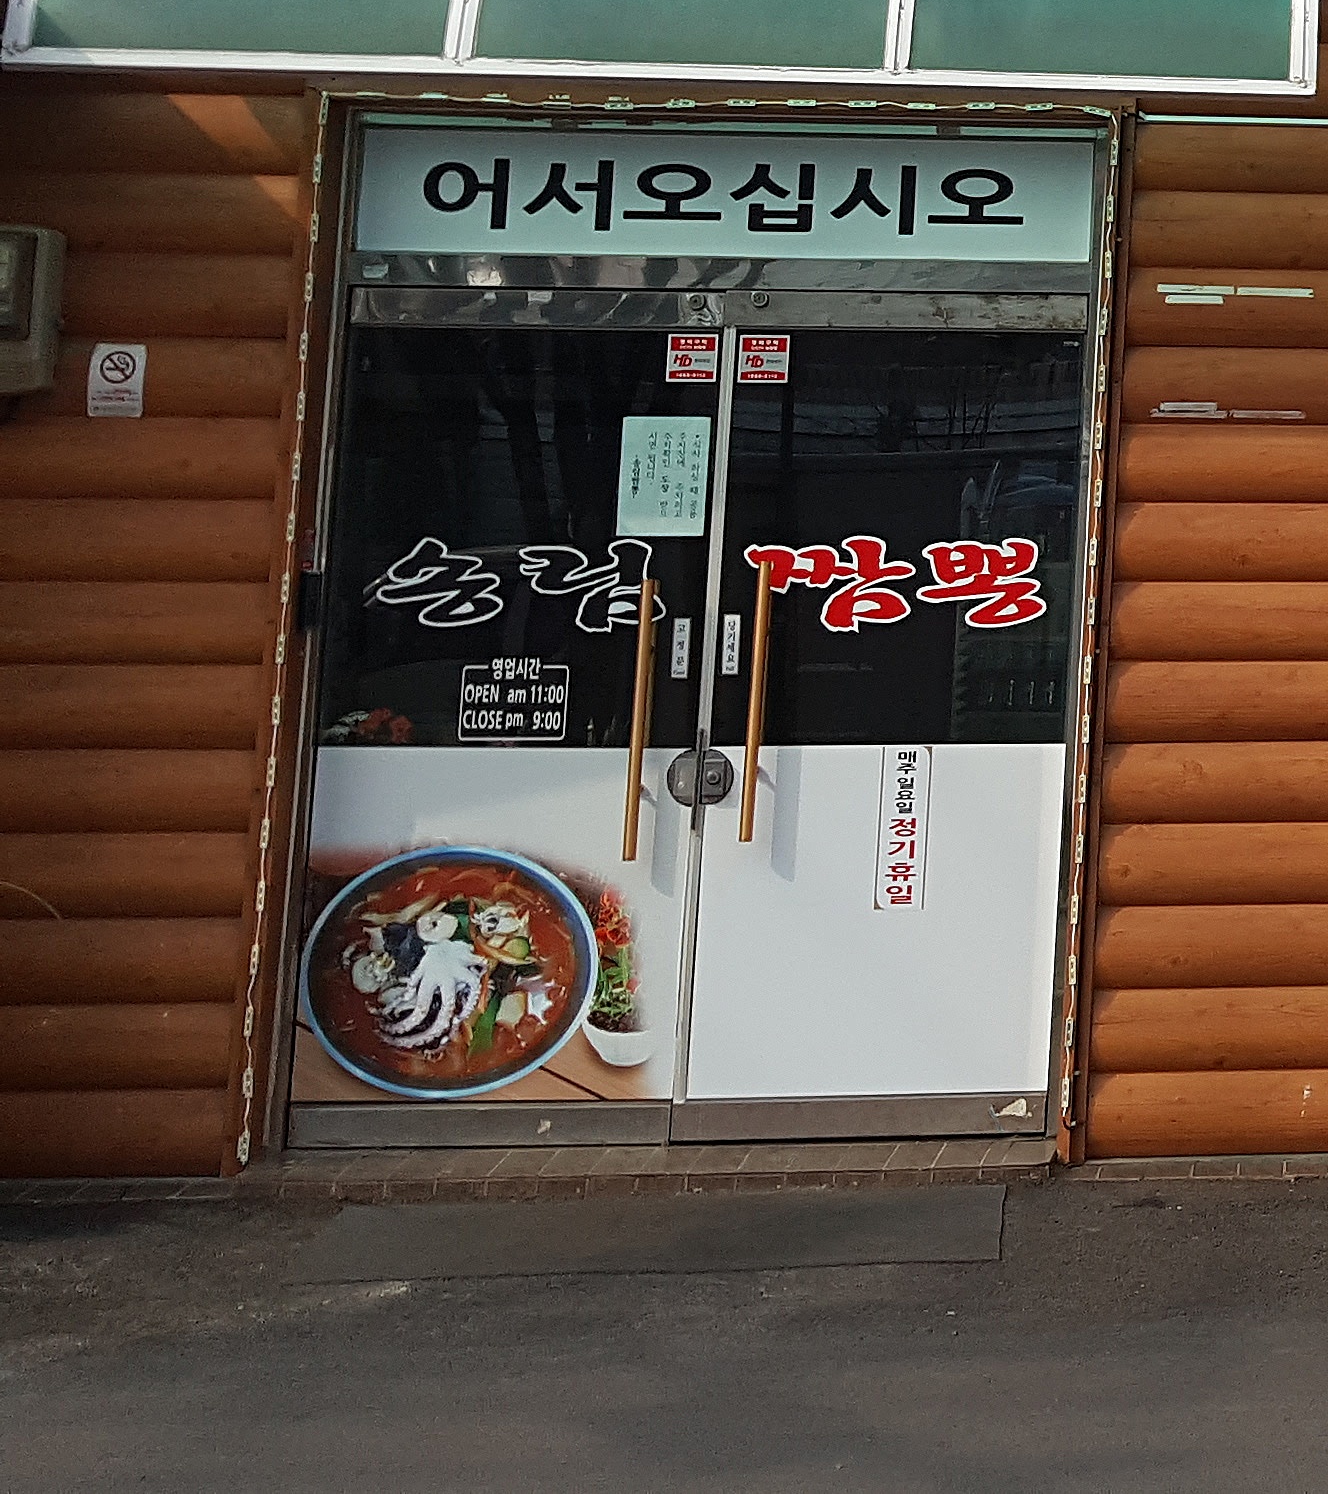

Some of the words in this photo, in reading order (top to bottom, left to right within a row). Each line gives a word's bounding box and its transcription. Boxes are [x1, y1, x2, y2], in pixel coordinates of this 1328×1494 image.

[423, 158, 1024, 236] 어서오십시오
[372, 539, 666, 633] 송림
[745, 536, 1047, 633] 짬뽕
[492, 657, 541, 680] 영업시간
[464, 684, 500, 704] OPEN
[507, 688, 527, 703] am
[531, 684, 564, 704] 11:00
[462, 710, 504, 729] CLOSE
[505, 712, 524, 730] pm
[532, 711, 561, 730] 9:00
[896, 750, 917, 775] 매주
[894, 777, 916, 814] 일요일
[884, 817, 917, 905] 정기휴일
